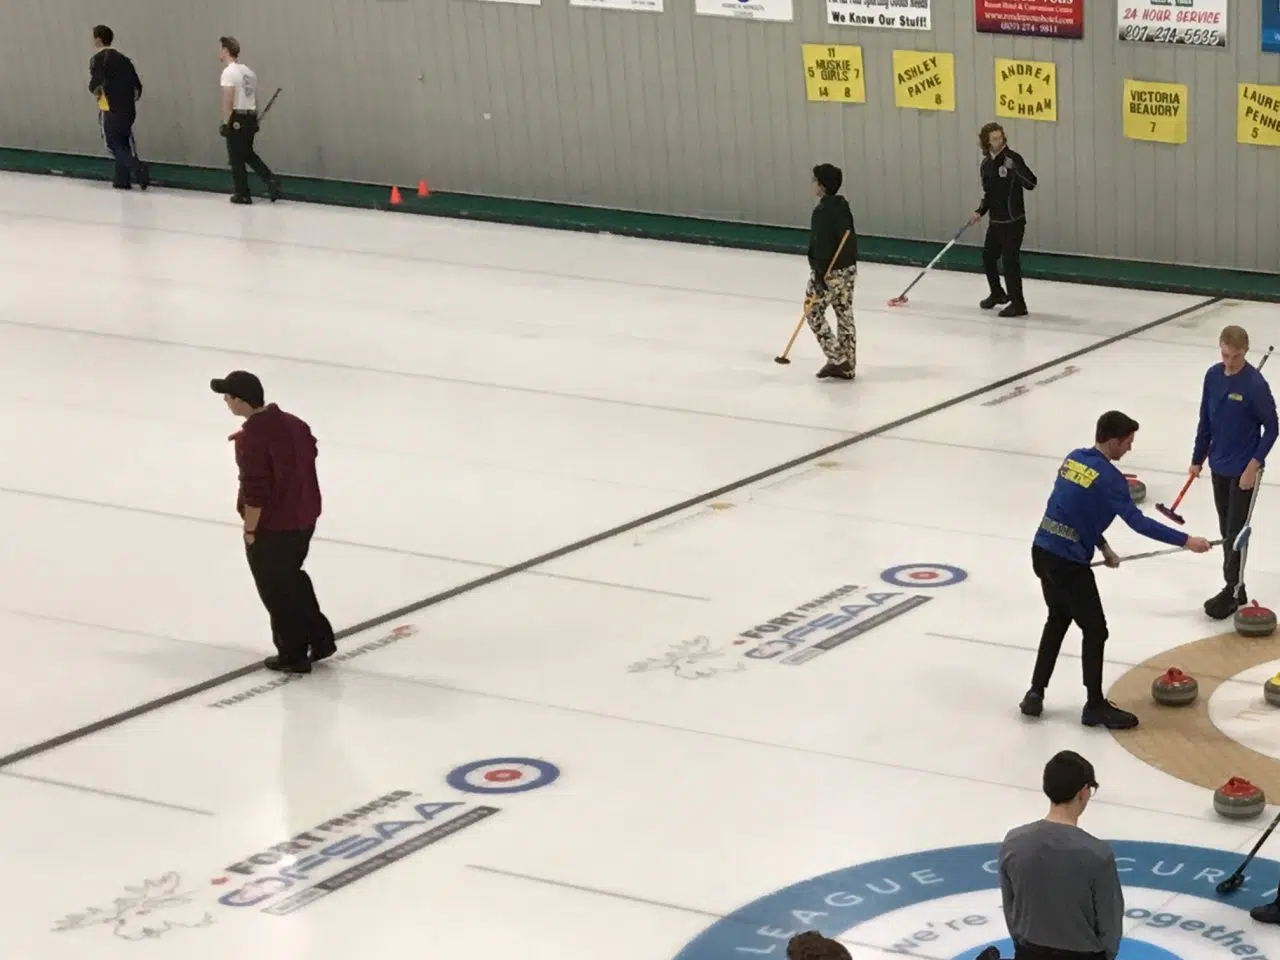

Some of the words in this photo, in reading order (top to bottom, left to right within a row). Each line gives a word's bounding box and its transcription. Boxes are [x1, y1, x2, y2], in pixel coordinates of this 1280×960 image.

[832, 11, 845, 22] We
[849, 12, 875, 24] Know
[879, 14, 895, 26] Our
[899, 15, 927, 27] Stuff!
[1123, 8, 1137, 20] 24
[1142, 9, 1172, 21] HOUR
[1176, 10, 1221, 24] SERVICE
[827, 48, 836, 58] 11
[808, 67, 815, 78] 5
[816, 59, 850, 71] MUSKIE
[897, 56, 937, 84] ASHLEY
[821, 70, 849, 82] GIRLS
[854, 69, 860, 79] 7
[1001, 64, 1051, 84] ANDREA
[819, 87, 829, 97] 14
[907, 74, 942, 97] PAYNE
[1018, 83, 1034, 95] 14
[1130, 89, 1180, 105] VICTORIA
[1000, 95, 1052, 116] SCHRAM
[1129, 103, 1180, 118] BEAUDRY
[1150, 122, 1156, 133] 7
[736, 868, 944, 956] LEAGUE
[891, 913, 988, 955] we're
